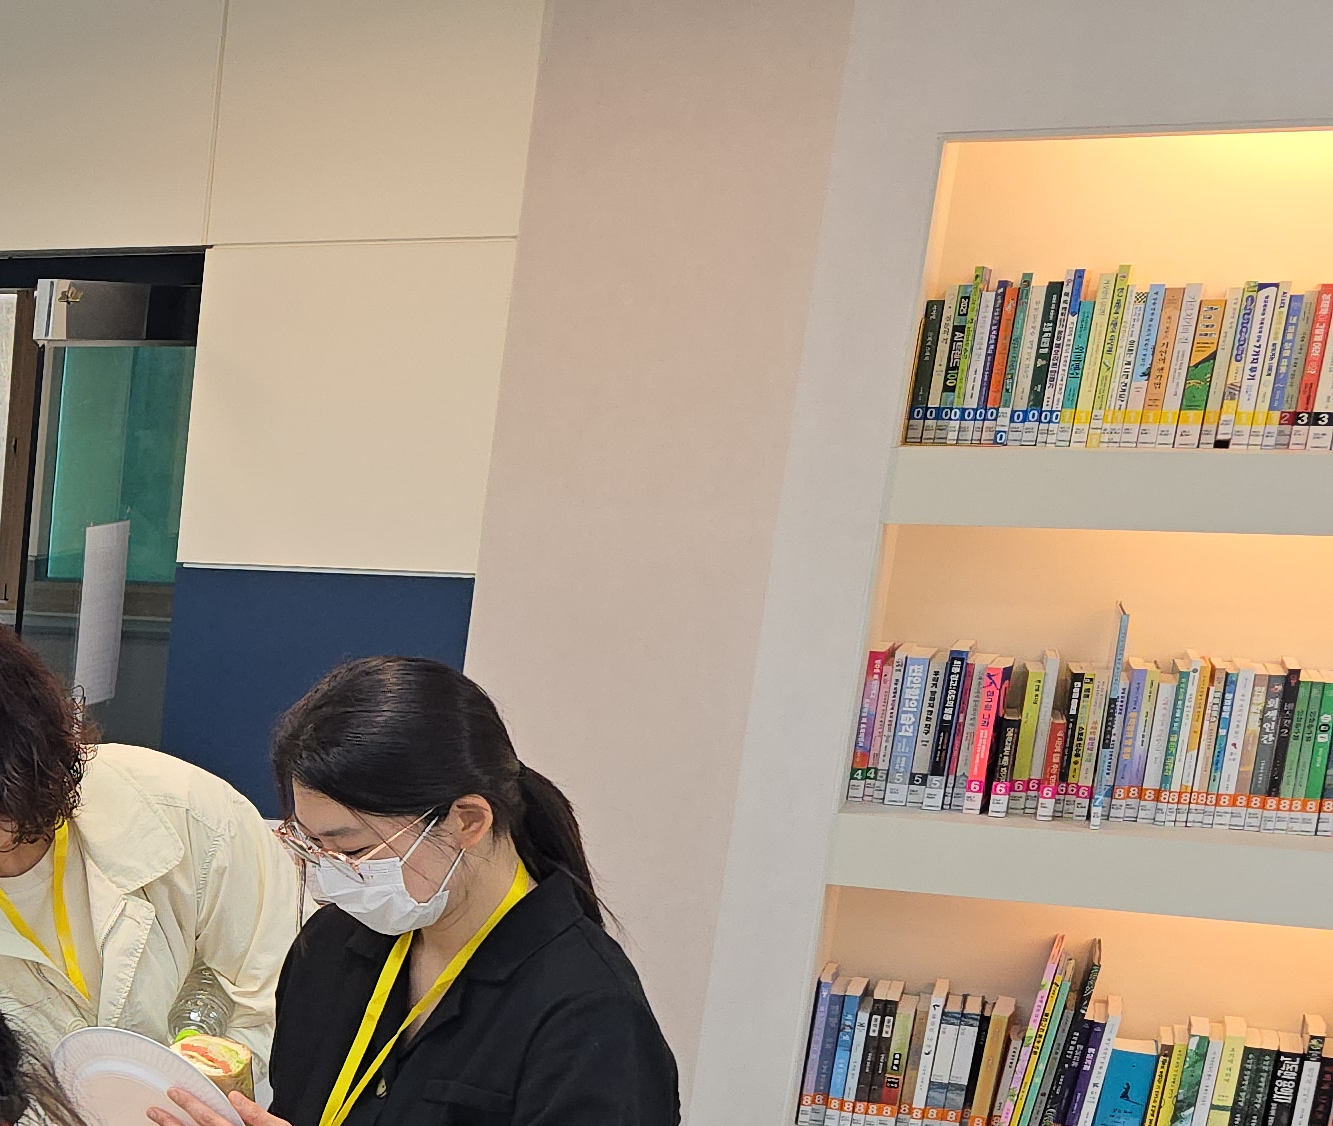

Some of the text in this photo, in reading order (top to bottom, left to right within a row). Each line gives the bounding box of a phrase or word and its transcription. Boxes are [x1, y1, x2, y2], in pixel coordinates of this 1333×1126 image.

[959, 298, 969, 315] 2025
[945, 331, 964, 386] AI 트렌드 100
[914, 408, 922, 418] 0
[927, 409, 935, 419] 0
[942, 409, 950, 419] 0
[951, 409, 960, 419] 0
[965, 409, 973, 420] 0
[976, 409, 985, 419] 0
[987, 409, 996, 419] 0
[1014, 412, 1023, 422] 0
[1029, 410, 1038, 421] 0
[1041, 412, 1050, 422] 0
[1052, 412, 1061, 422] 0
[1281, 413, 1290, 423] 2
[1298, 413, 1308, 424] 3
[1318, 414, 1329, 425] 3
[997, 432, 1005, 443] 0
[898, 664, 923, 736] 편안함의 습격
[854, 770, 862, 779] 4
[867, 769, 875, 778] 4
[894, 773, 903, 783] 5
[914, 775, 922, 784] 5
[931, 777, 940, 787] 5
[971, 781, 979, 791] 6
[996, 784, 1006, 794] 6
[1015, 781, 1023, 791] 6
[1029, 780, 1038, 790] 6
[1068, 784, 1077, 794] 6
[1043, 787, 1052, 797] 6
[1079, 787, 1088, 797] 6
[1115, 789, 1124, 798] 8
[1129, 787, 1138, 798] 8
[1145, 790, 1154, 800] 8
[1161, 788, 1169, 802] 8
[1169, 793, 1178, 803] 8
[1181, 793, 1189, 803] 8
[1198, 793, 1206, 804] 8
[1207, 795, 1215, 805] 8
[1220, 795, 1229, 805] 8
[1236, 796, 1247, 806] 8
[1251, 797, 1260, 807] 8
[1266, 799, 1276, 810] 8
[1280, 800, 1290, 810] 8
[1292, 800, 1301, 811] 8
[1306, 801, 1316, 812] 8
[1323, 801, 1333, 812] 8
[1273, 1055, 1301, 1103] 고독한 용의자
[803, 1096, 811, 1105] 8
[831, 1099, 839, 1109] 8
[844, 1102, 852, 1111] 8
[855, 1102, 866, 1113] 8
[868, 1105, 877, 1115] 8
[883, 1106, 891, 1116] 8
[913, 1109, 922, 1118] 8
[928, 1109, 937, 1118] 8
[947, 1111, 956, 1121] 8
[974, 1118, 982, 1126] 8
